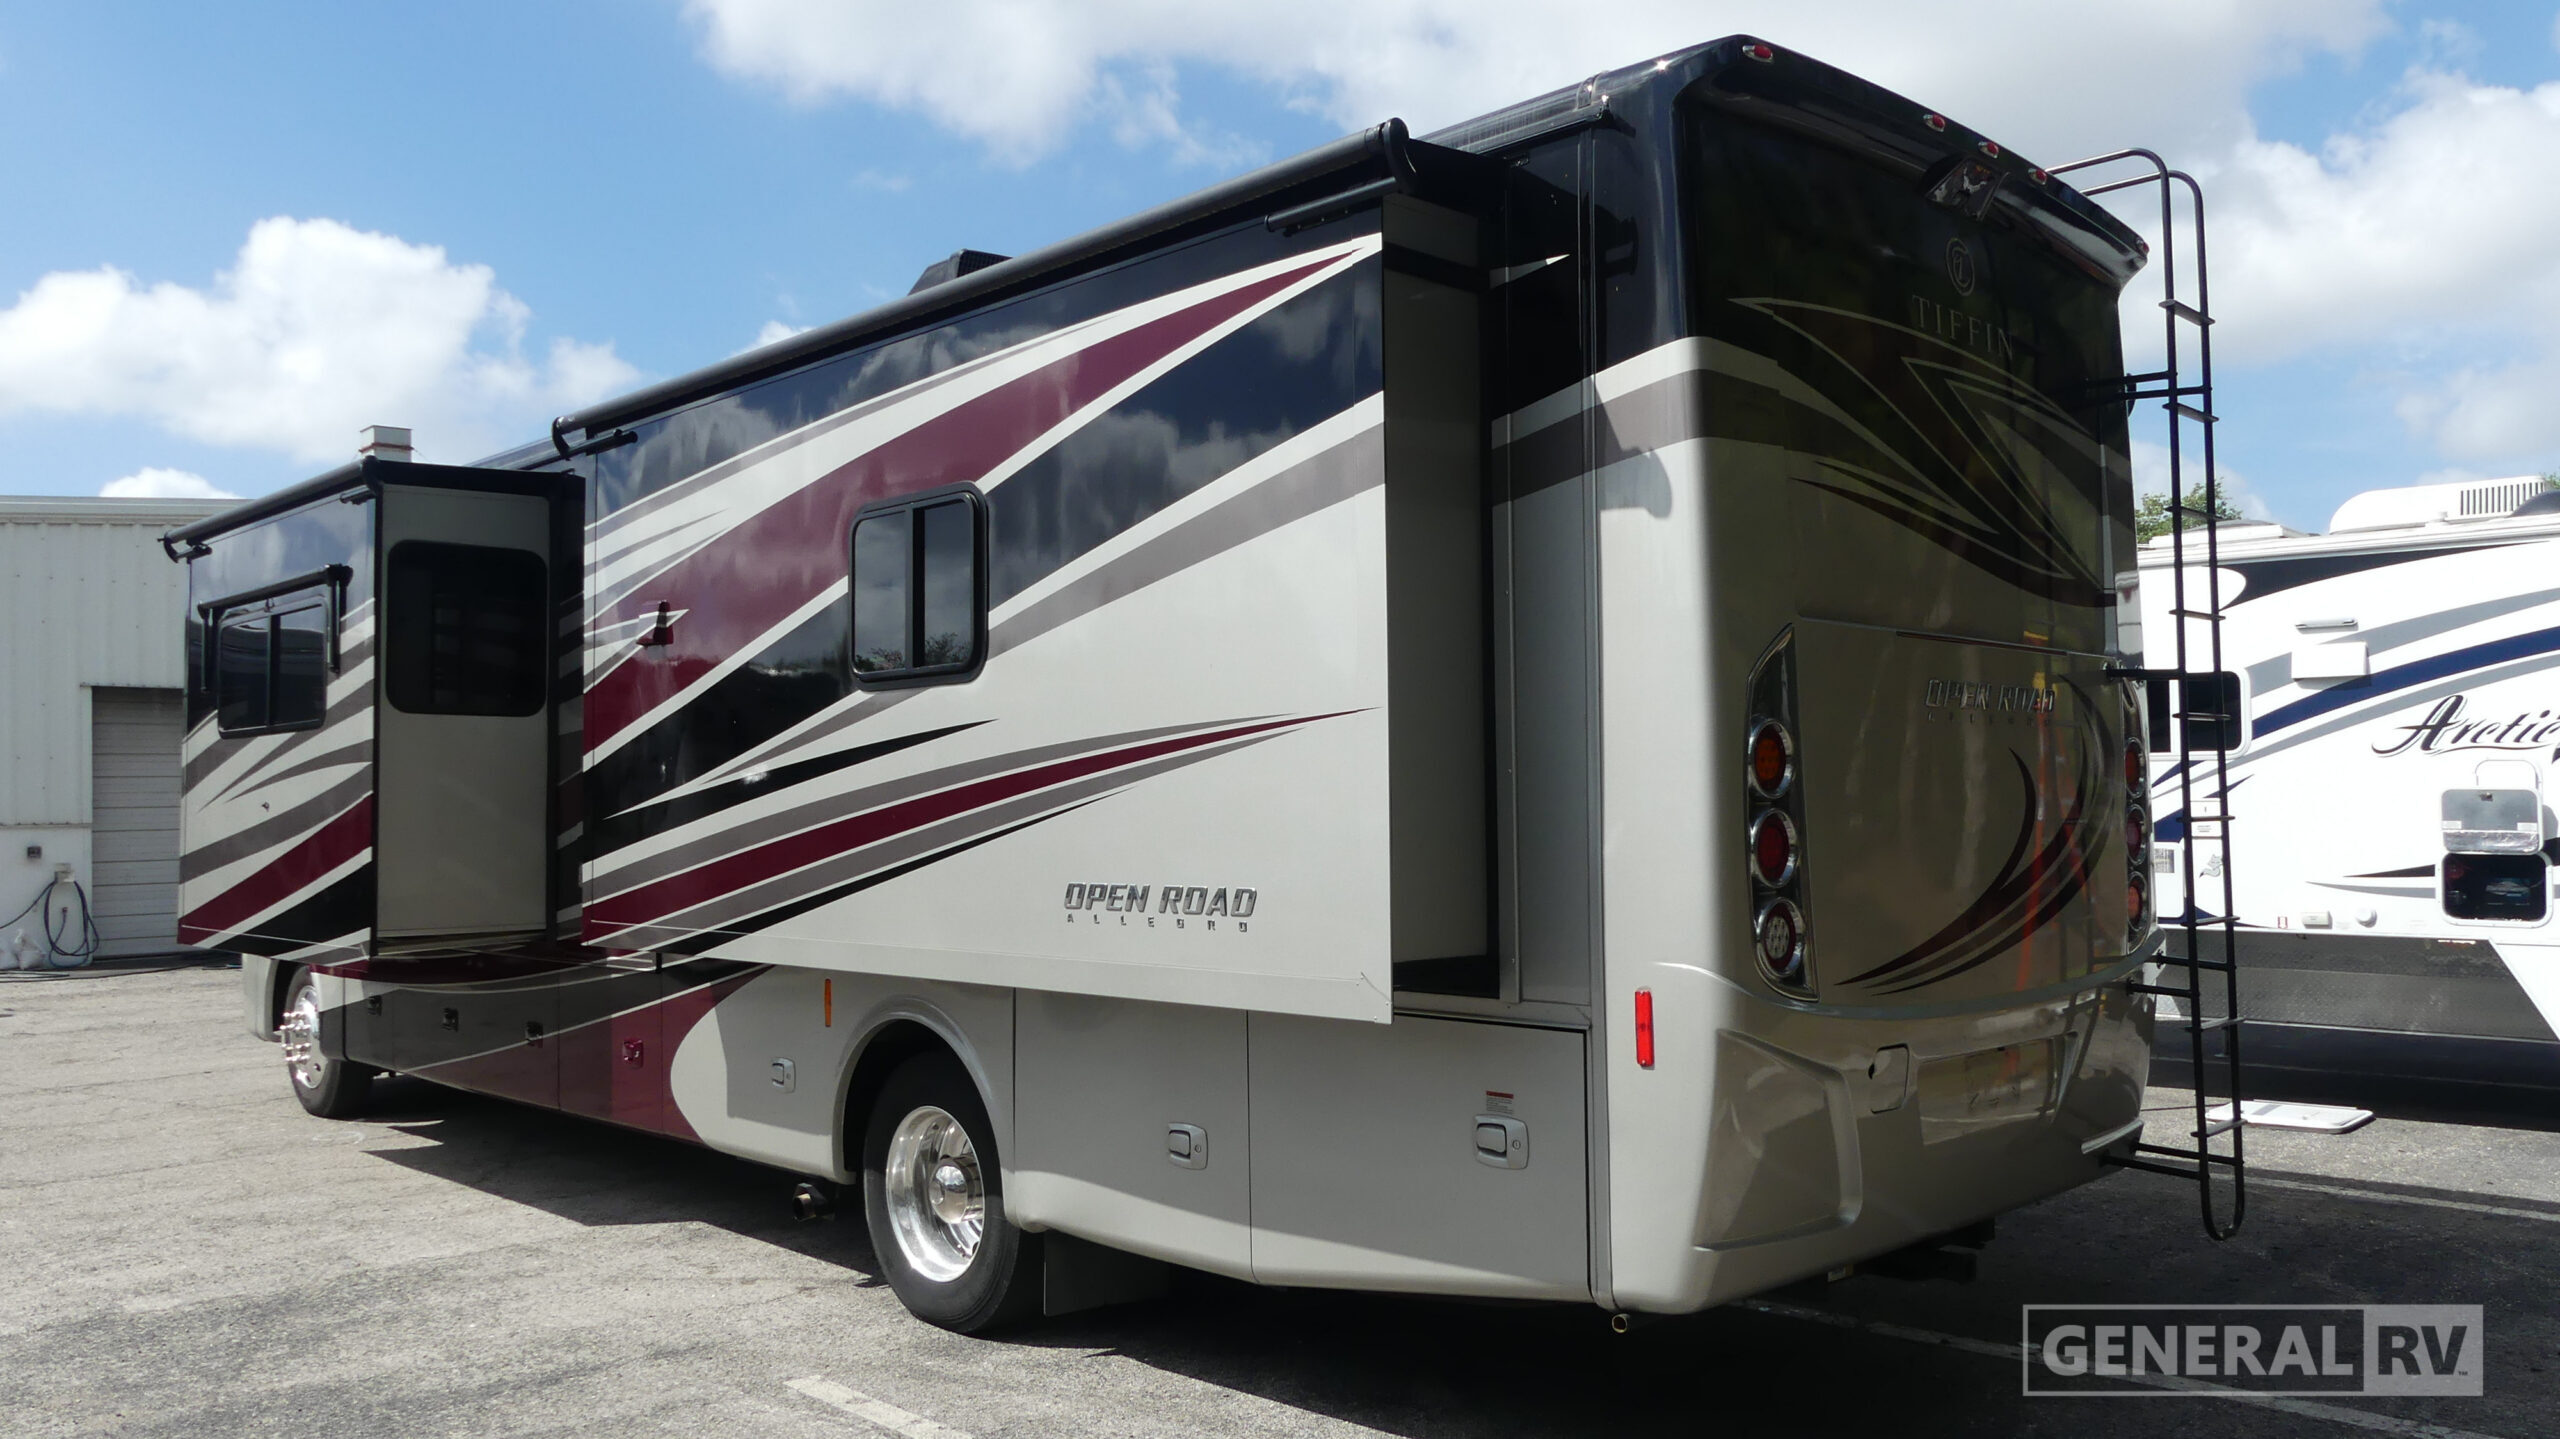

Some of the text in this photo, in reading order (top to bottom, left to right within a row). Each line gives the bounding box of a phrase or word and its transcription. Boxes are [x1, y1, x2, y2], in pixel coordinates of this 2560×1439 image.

[1911, 294, 2014, 361] TIFFIN
[1926, 679, 2056, 713] OPEN ROAD
[2372, 694, 2560, 757] Arctic
[1064, 882, 1257, 917] OPEN ROAD
[1067, 913, 1248, 932] ALLEGRO
